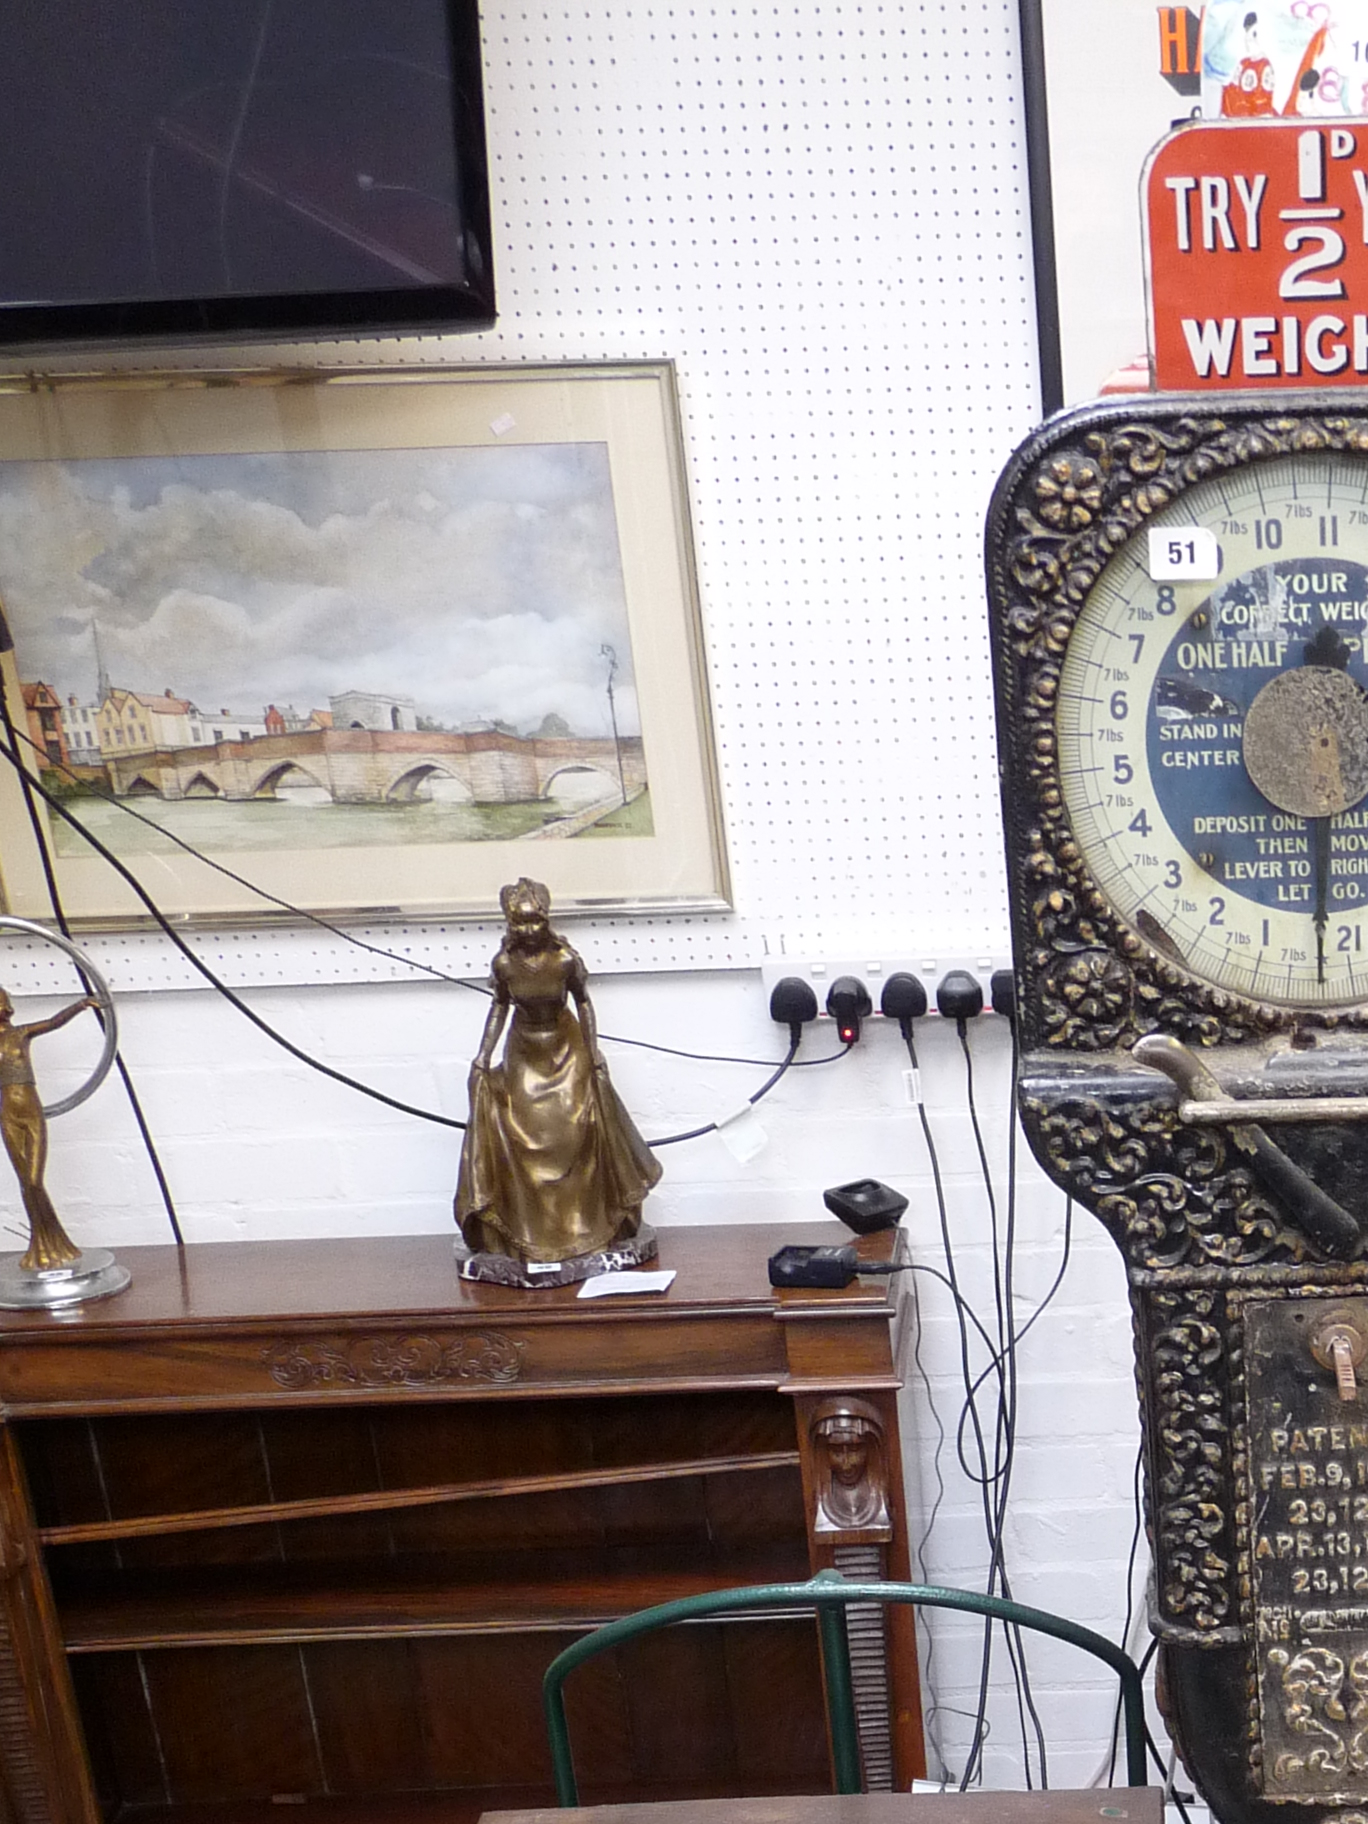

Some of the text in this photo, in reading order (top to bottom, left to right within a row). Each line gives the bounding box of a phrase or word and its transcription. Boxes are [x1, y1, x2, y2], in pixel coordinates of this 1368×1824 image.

[1157, 6, 1201, 74] H
[1164, 174, 1268, 251] TRY
[1255, 518, 1283, 550] 10
[1319, 515, 1339, 547] 11
[1167, 540, 1196, 565] 51
[1275, 572, 1347, 594] YOUR
[1156, 585, 1177, 617] 8
[1128, 633, 1145, 664] 7
[1177, 641, 1228, 670] ONE
[1232, 640, 1288, 669] HALF
[1110, 690, 1129, 721] 6
[1159, 722, 1243, 741] STAND IN
[1112, 754, 1134, 785] 5
[1161, 750, 1240, 767] CENTER
[1128, 808, 1153, 838] 4
[1193, 815, 1267, 834] DEPOSIT
[1271, 813, 1307, 831] ONE
[1256, 837, 1308, 854] THEN
[1163, 859, 1183, 889] 3
[1224, 861, 1283, 880] LEVER
[1287, 860, 1311, 877] TO
[1277, 881, 1366, 902] LET GO.
[1208, 896, 1226, 926] 2
[1337, 925, 1361, 952] 21
